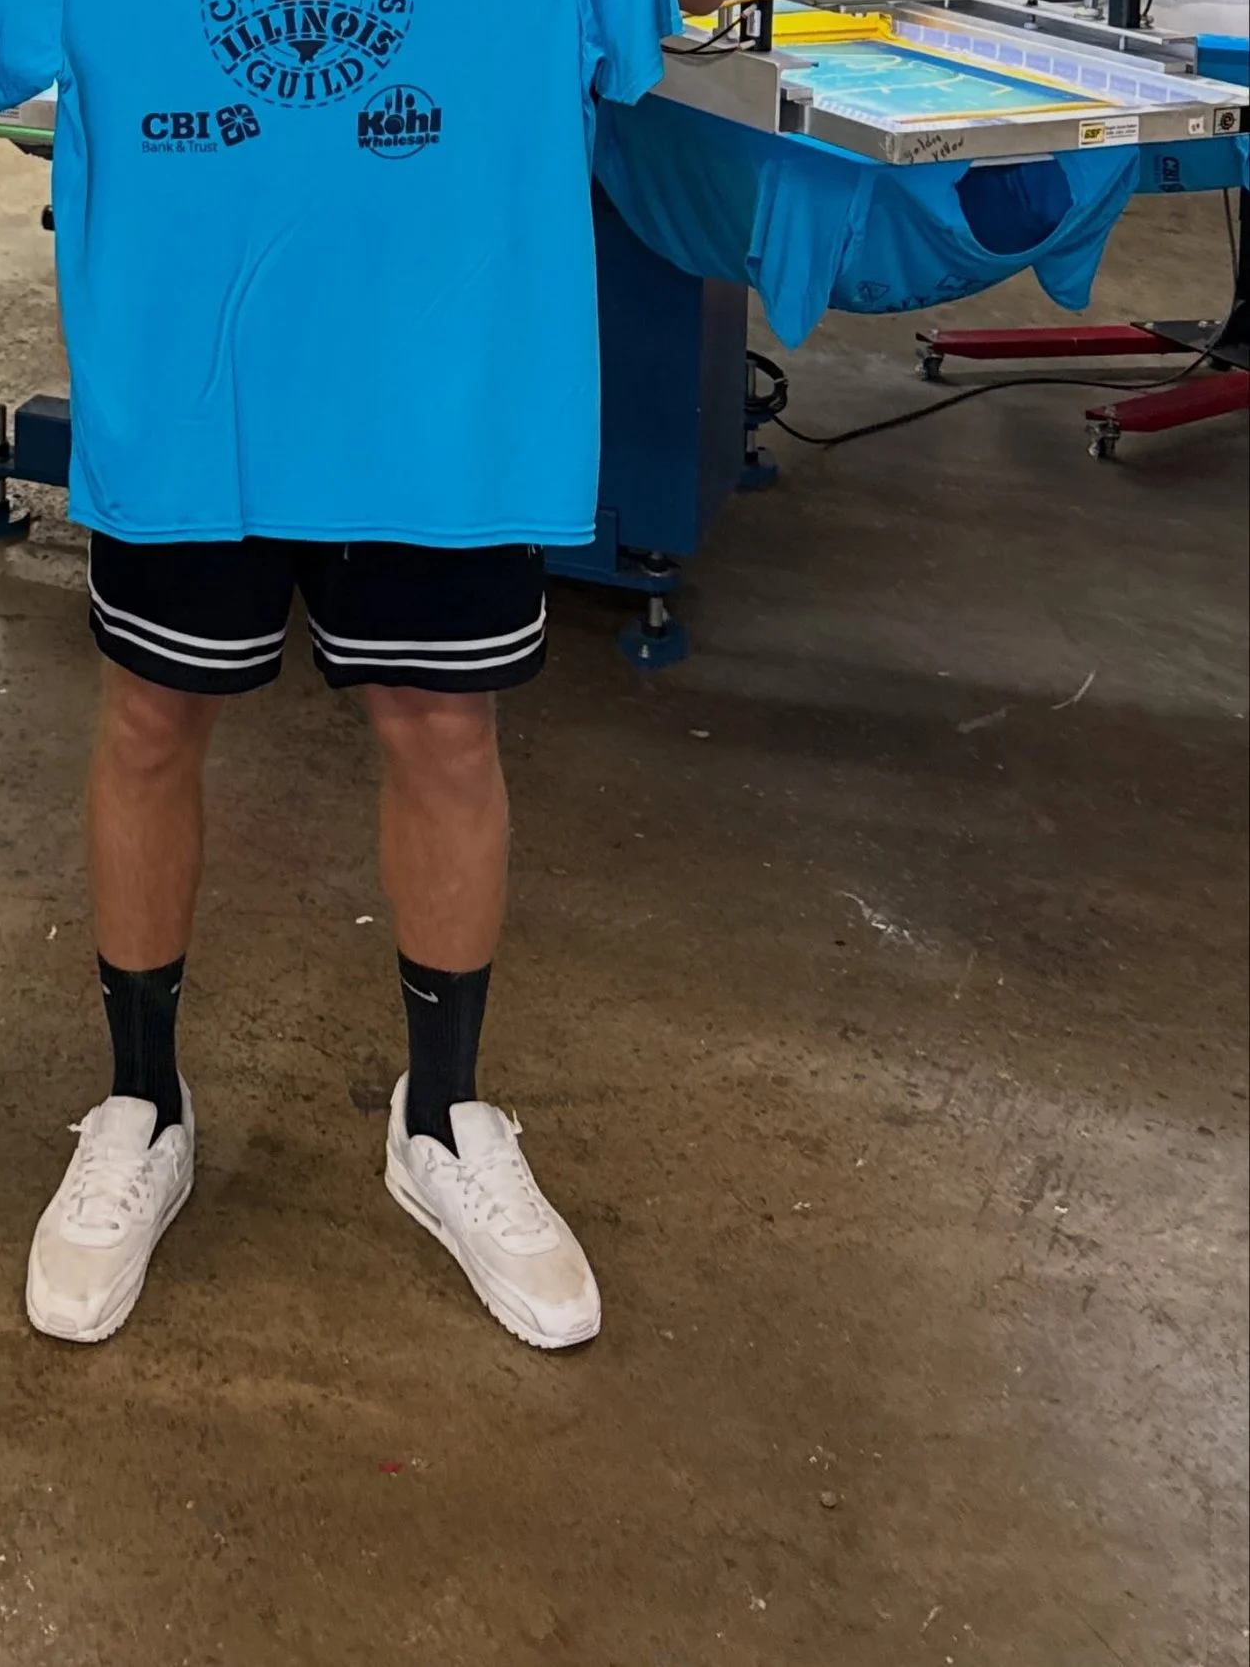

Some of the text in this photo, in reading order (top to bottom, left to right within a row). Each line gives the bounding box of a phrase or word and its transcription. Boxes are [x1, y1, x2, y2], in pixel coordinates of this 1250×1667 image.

[219, 7, 398, 62] ILLINOIS
[246, 57, 364, 101] GUILD
[142, 111, 210, 140] CBI
[358, 107, 442, 136] Kohl
[142, 140, 218, 153] Bank & Trust
[358, 133, 440, 148] Wholesale
